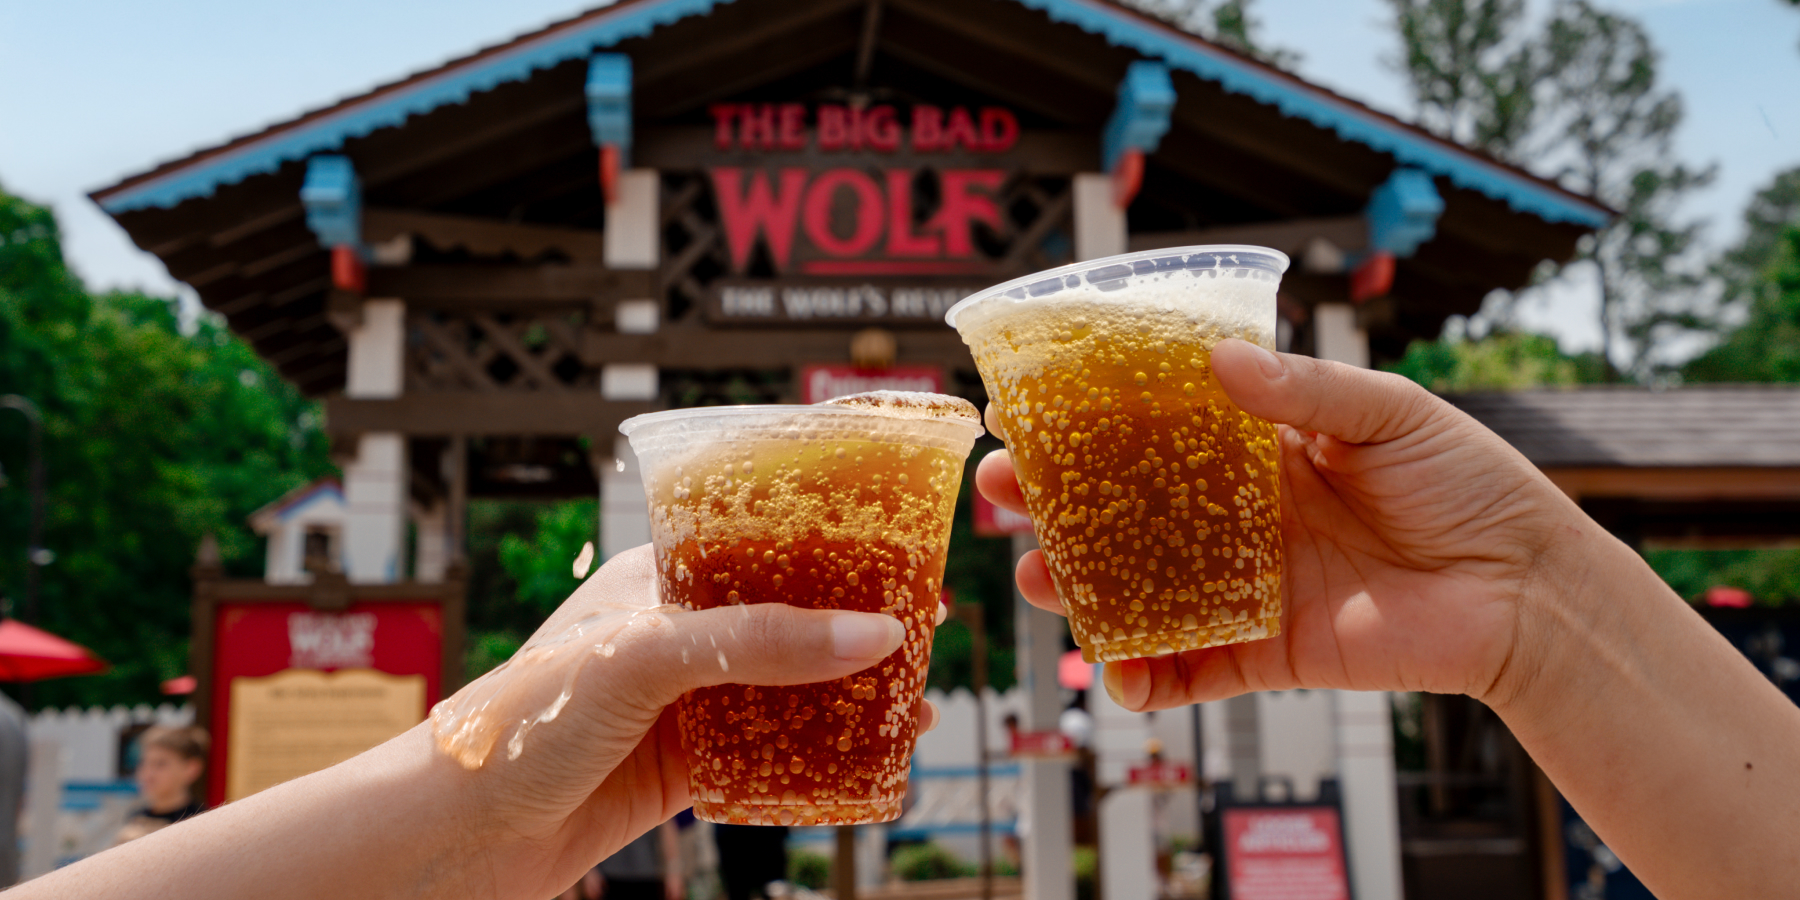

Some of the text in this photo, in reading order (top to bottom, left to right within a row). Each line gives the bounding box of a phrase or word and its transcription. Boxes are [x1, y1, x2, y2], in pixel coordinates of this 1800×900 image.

[709, 104, 1019, 151] THE BIG BAD
[710, 166, 1005, 273] WOLF
[721, 287, 774, 318] THE
[781, 284, 889, 320] WOLF'S
